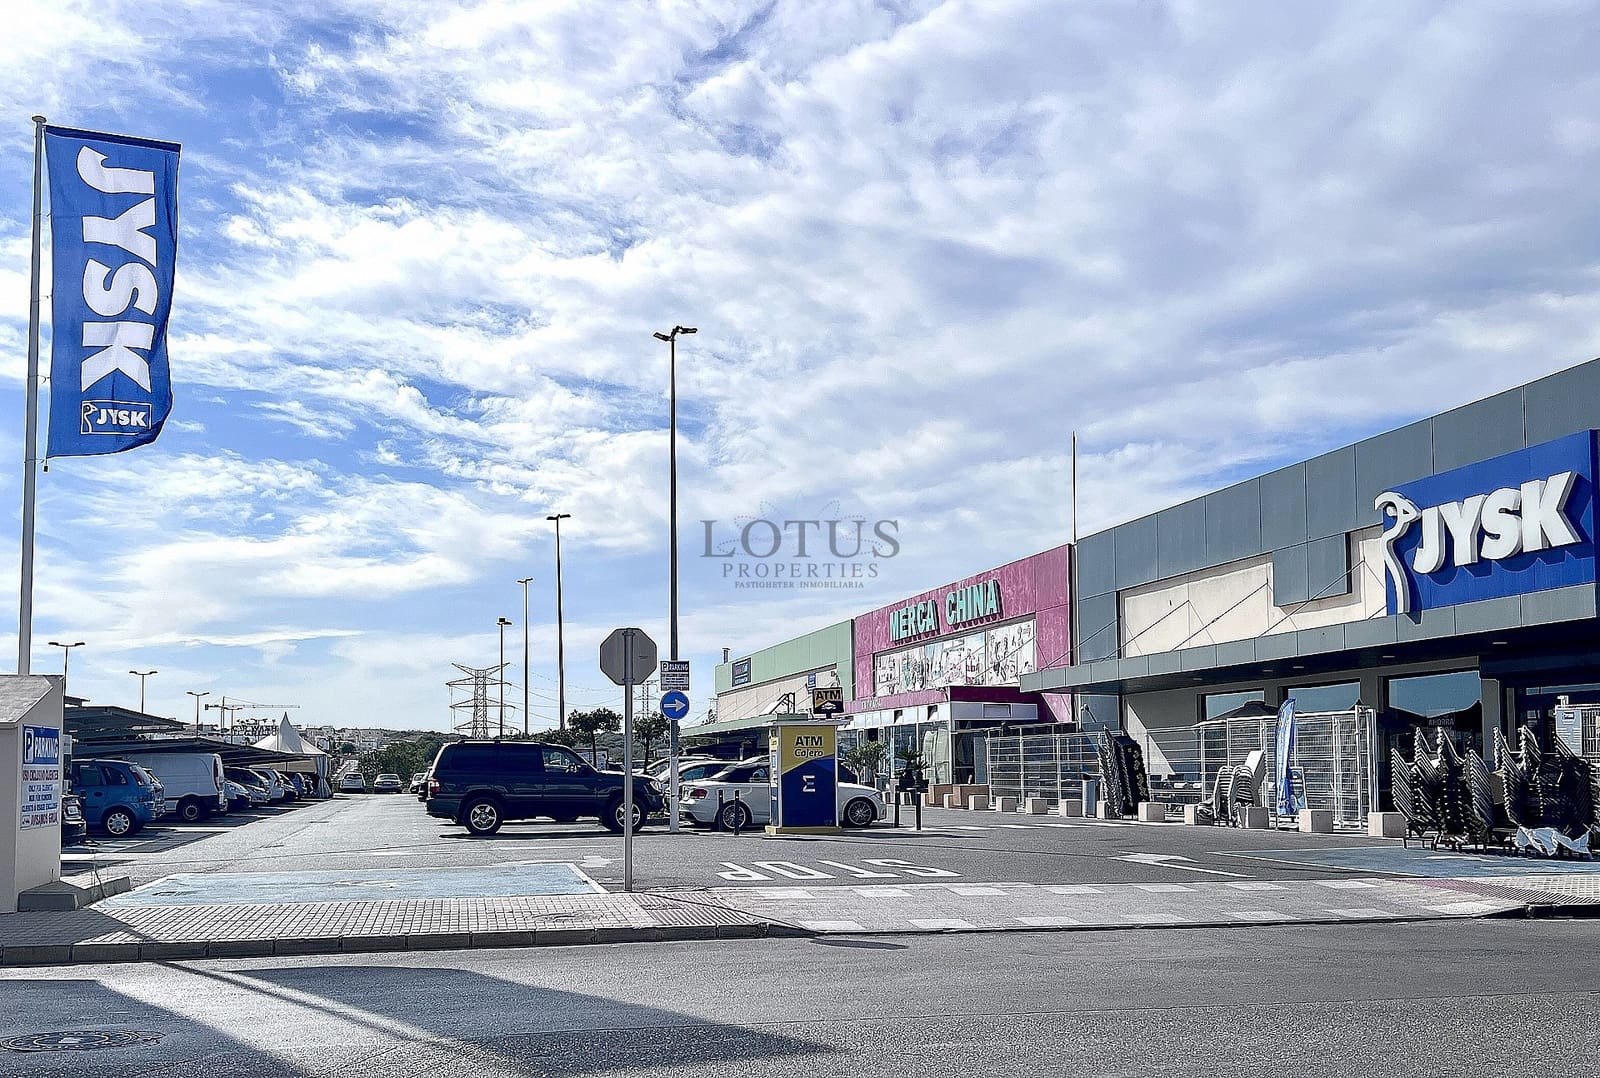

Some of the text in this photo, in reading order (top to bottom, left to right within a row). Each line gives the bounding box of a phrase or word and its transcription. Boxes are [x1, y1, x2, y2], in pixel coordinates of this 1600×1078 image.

[76, 145, 159, 393] JYSK
[96, 408, 147, 427] JYSK
[1412, 471, 1582, 574] JYSK
[889, 580, 1001, 642] MERCA CHINA
[670, 663, 688, 671] PARKING
[816, 690, 841, 700] ATM
[34, 737, 58, 758] PARKING
[795, 736, 823, 746] ATM
[794, 748, 823, 758] Cajero
[716, 858, 962, 881] STOP
